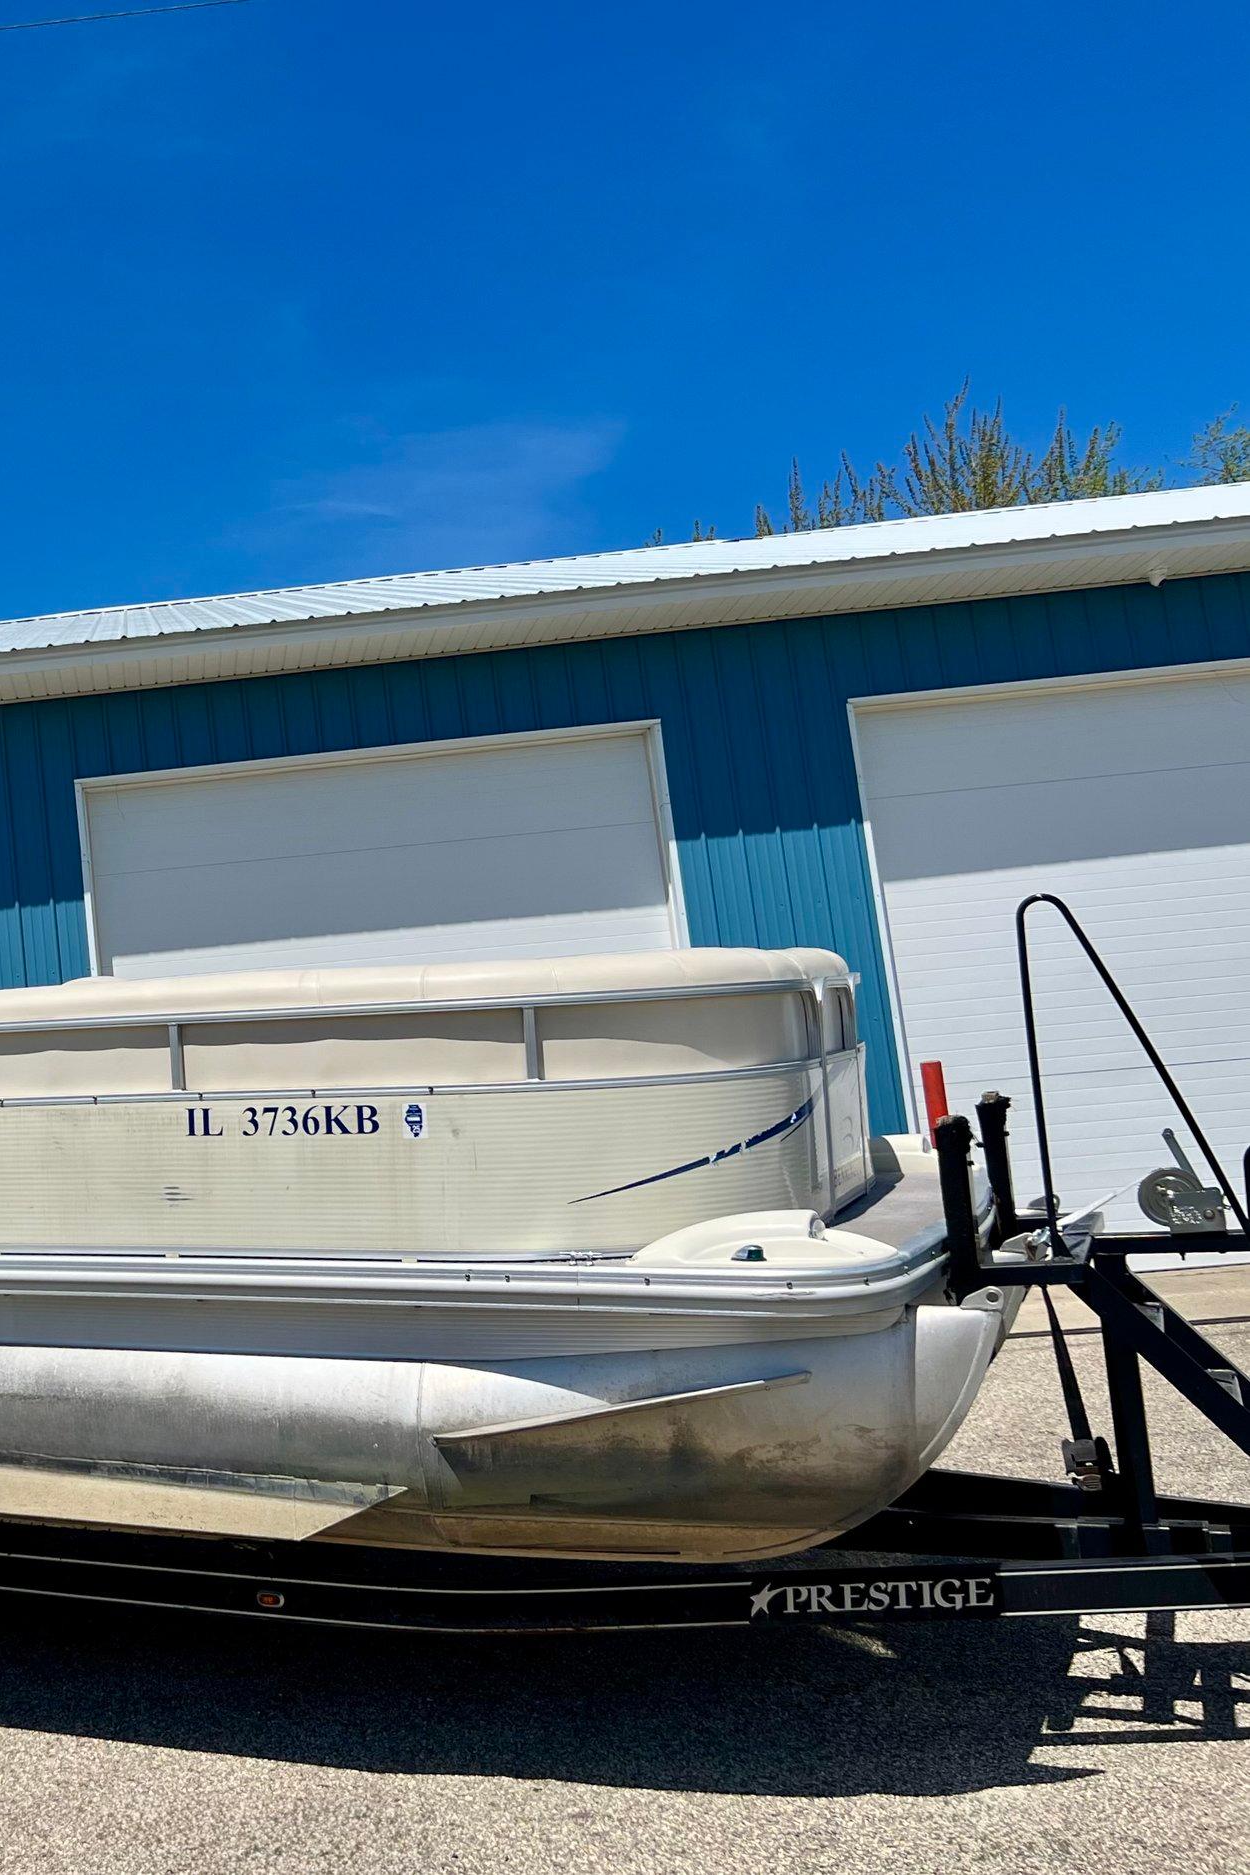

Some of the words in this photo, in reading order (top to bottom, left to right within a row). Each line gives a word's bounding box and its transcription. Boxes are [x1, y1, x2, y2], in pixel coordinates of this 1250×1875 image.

[185, 1107, 224, 1136] IL
[241, 1104, 380, 1136] 3736KB
[782, 1578, 995, 1614] PRESTIGE
